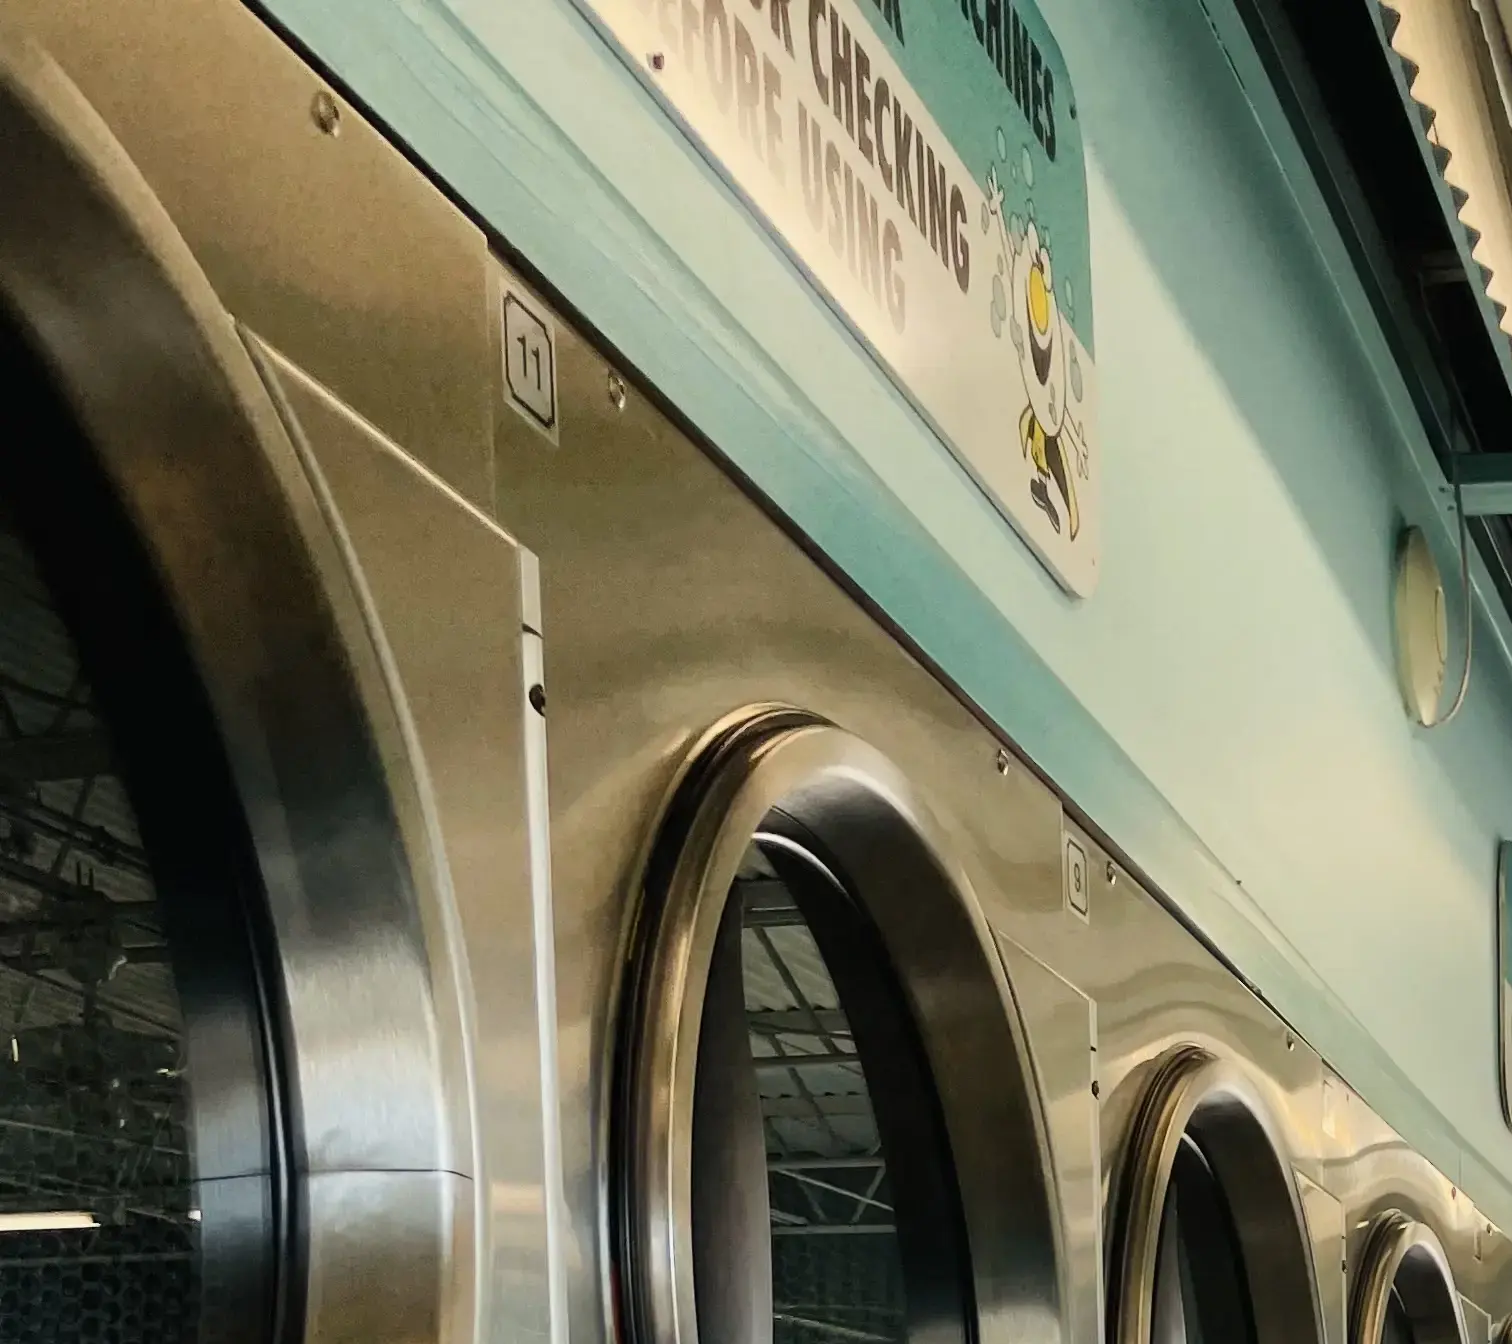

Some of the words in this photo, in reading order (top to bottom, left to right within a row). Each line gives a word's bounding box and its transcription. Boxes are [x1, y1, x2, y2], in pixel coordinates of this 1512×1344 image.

[808, 0, 970, 294] CHECKING
[956, 0, 1056, 162] HINES
[798, 100, 906, 336] USING
[517, 333, 541, 391] 11
